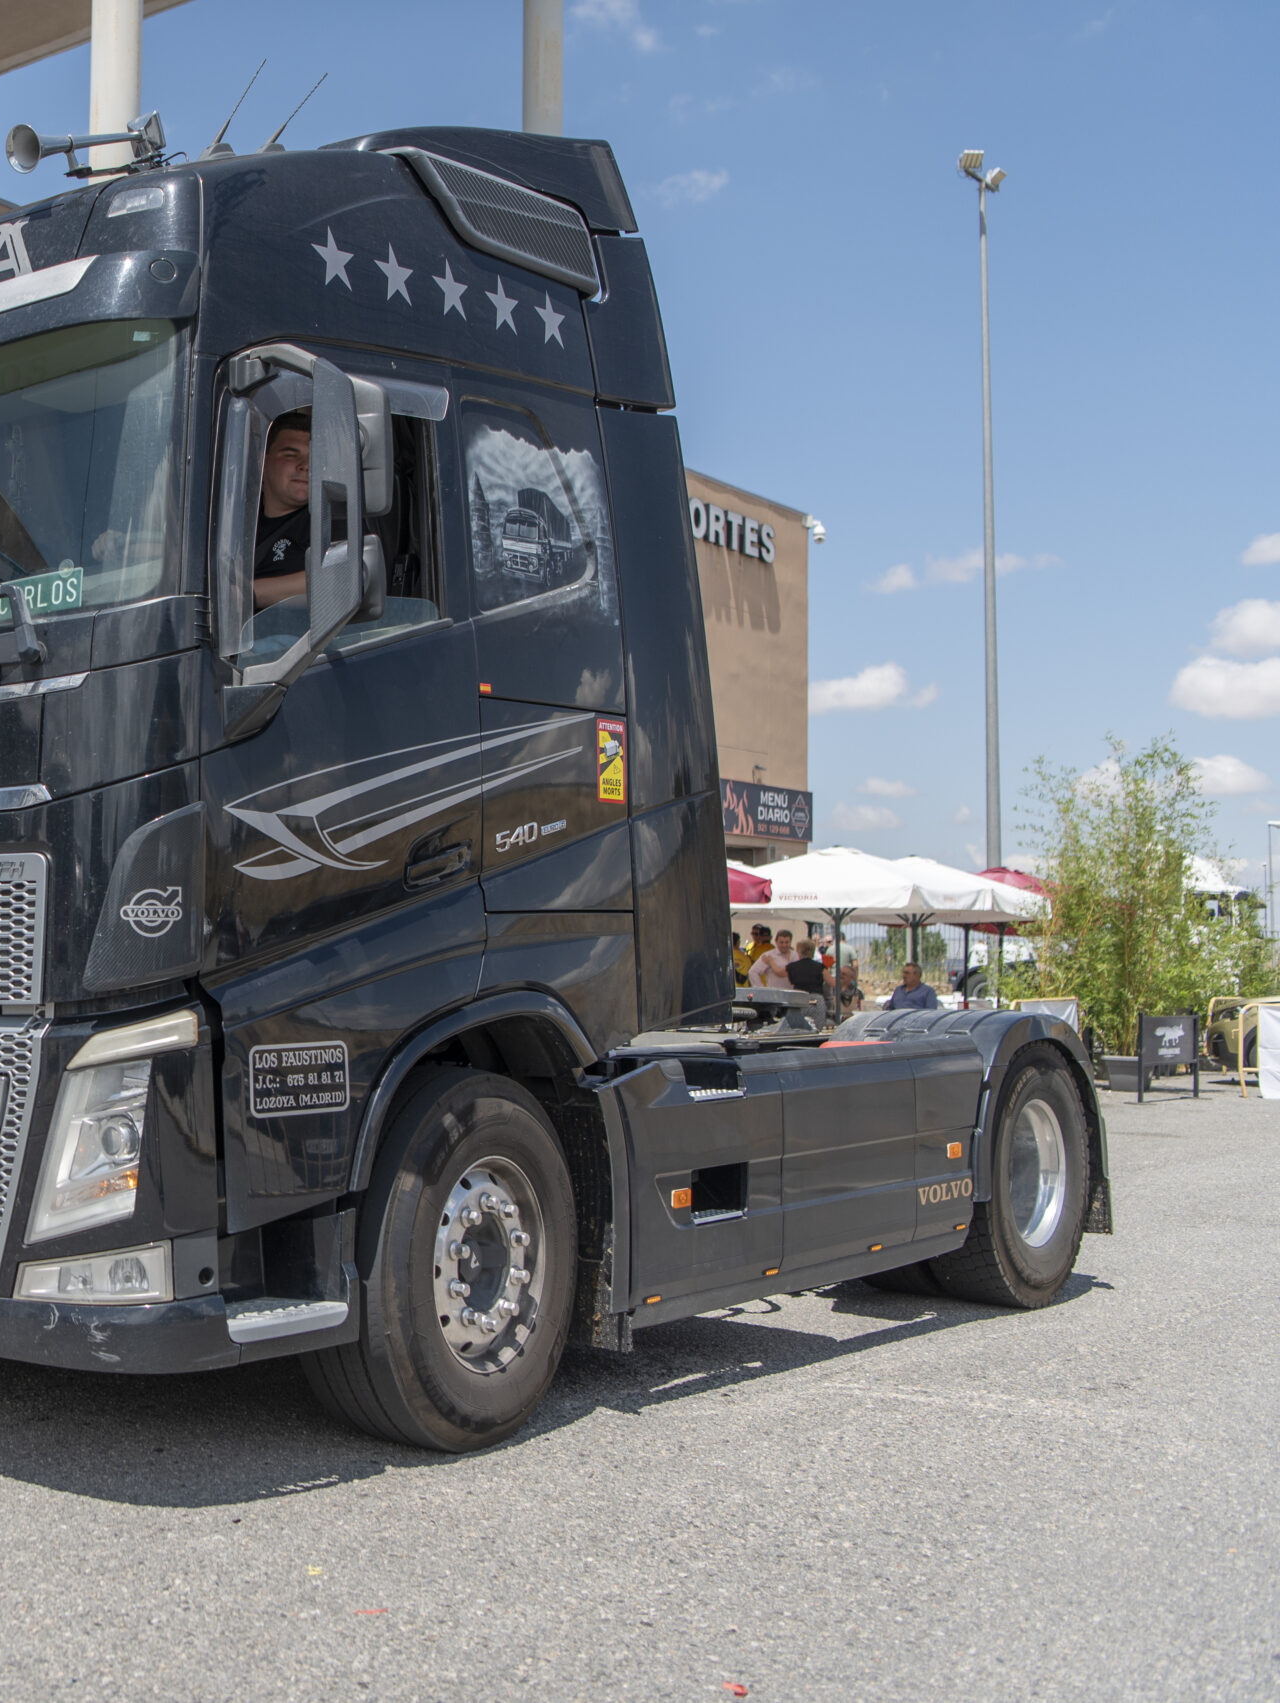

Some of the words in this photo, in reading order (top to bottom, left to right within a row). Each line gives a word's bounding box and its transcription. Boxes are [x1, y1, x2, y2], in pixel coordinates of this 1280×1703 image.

[689, 497, 776, 564] ORTES
[598, 721, 624, 733] ATTENTION
[601, 777, 622, 787] ANGLES
[602, 786, 621, 796] MORTS
[760, 791, 788, 806] MENÚ
[757, 805, 791, 824] DIARIO
[495, 821, 538, 853] 540
[778, 894, 819, 902] VICTORIA
[126, 907, 179, 918] VOLVO
[255, 1052, 278, 1069] LOS
[281, 1048, 344, 1068] FAUSTINOS
[255, 1075, 280, 1090] J.C.:
[286, 1073, 305, 1087] 675
[307, 1072, 319, 1085] 81
[321, 1071, 332, 1084] 81
[333, 1070, 344, 1083] 71
[256, 1095, 297, 1110] LOZOYA
[298, 1091, 345, 1107] (MADRID)
[917, 1178, 973, 1206] VOLVO
